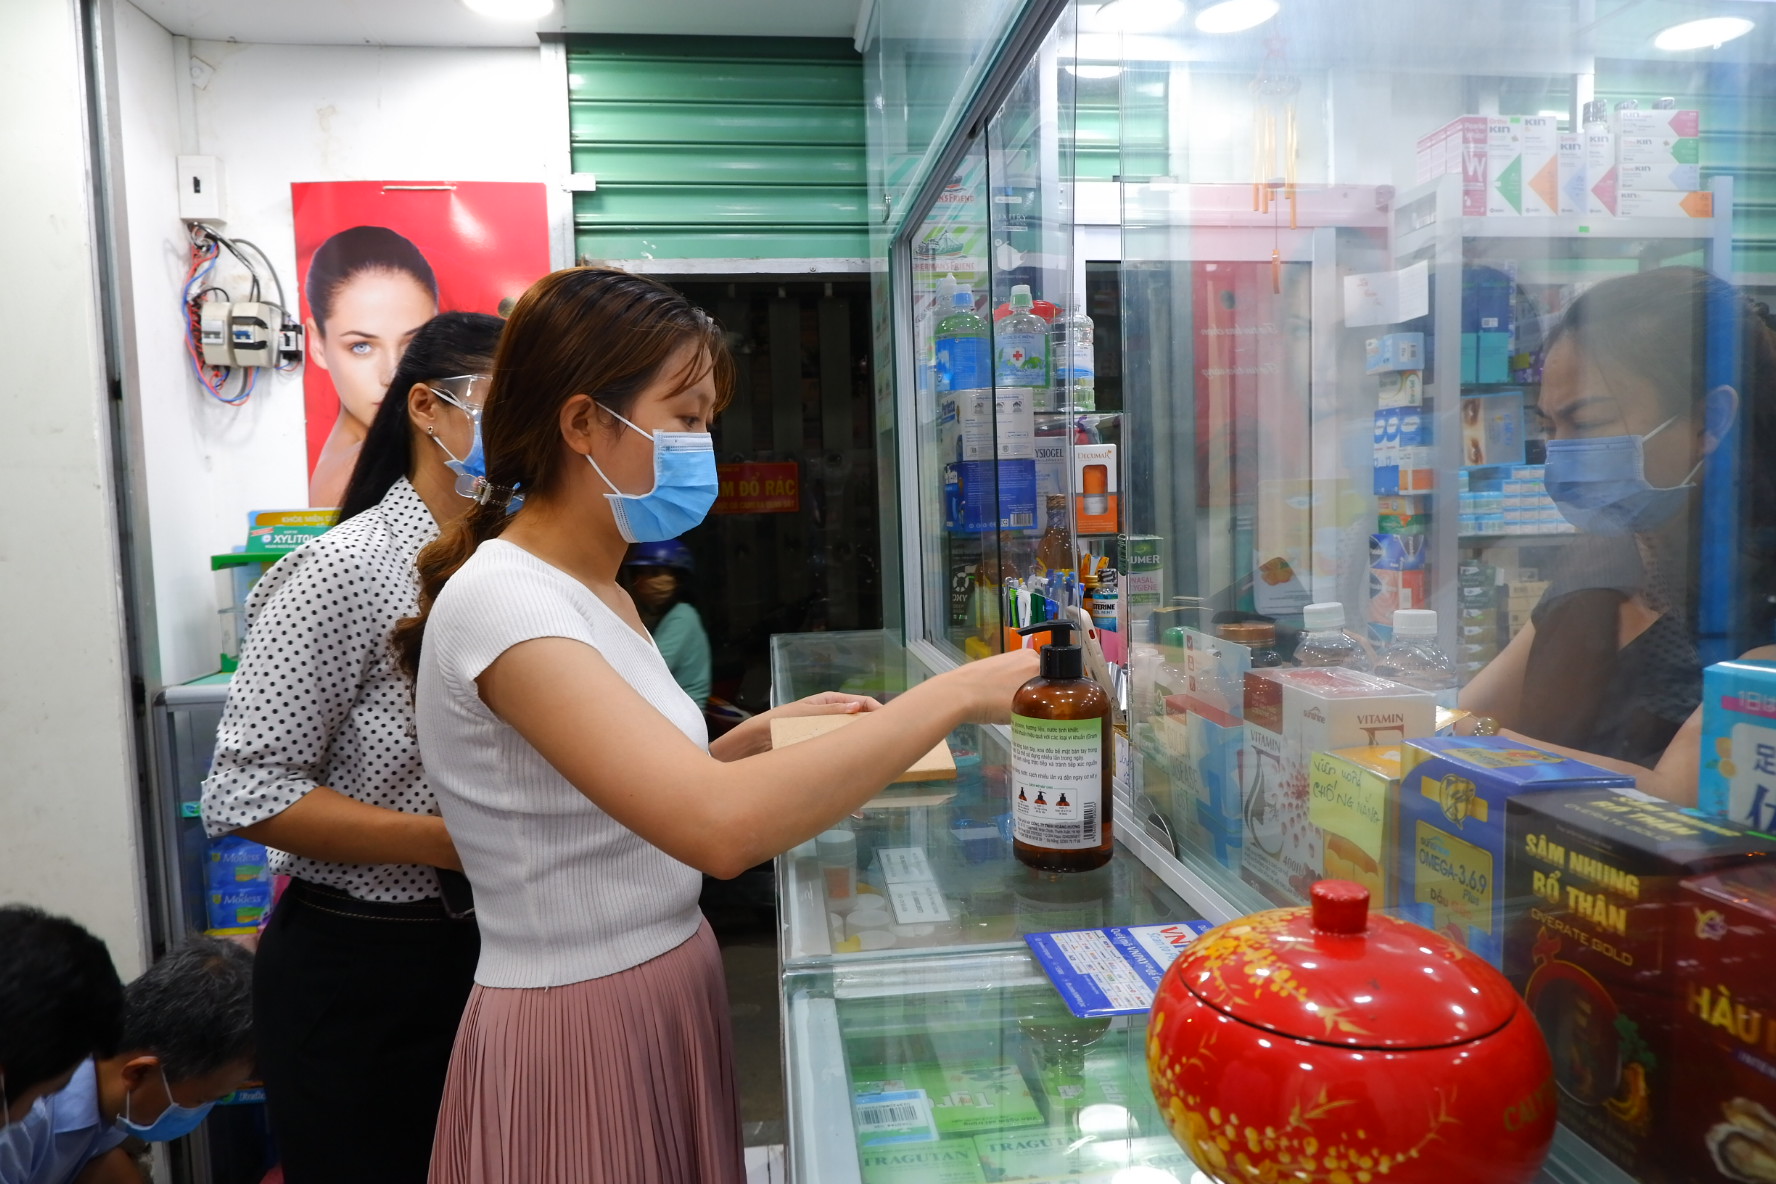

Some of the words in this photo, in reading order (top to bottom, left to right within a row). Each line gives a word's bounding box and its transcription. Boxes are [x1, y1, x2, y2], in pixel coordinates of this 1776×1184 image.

[740, 472, 760, 496] ĐỔ
[765, 474, 796, 496] RÁC
[1304, 708, 1326, 724] sunshine
[1358, 714, 1404, 724] VITAMIN
[1250, 728, 1280, 750] VITAMIN
[1420, 849, 1488, 895] OMEGA-3.6.9
[1526, 832, 1566, 868] SÂM
[1570, 850, 1640, 900] NHUNG
[224, 894, 262, 905] Modess
[1533, 870, 1562, 904] BỔ
[1566, 885, 1627, 936] THẬN
[1532, 907, 1590, 946] OVERATE
[1592, 938, 1634, 966] GOLD
[1688, 984, 1762, 1044] HÀU
[864, 1150, 969, 1167] TRAGUTAN
